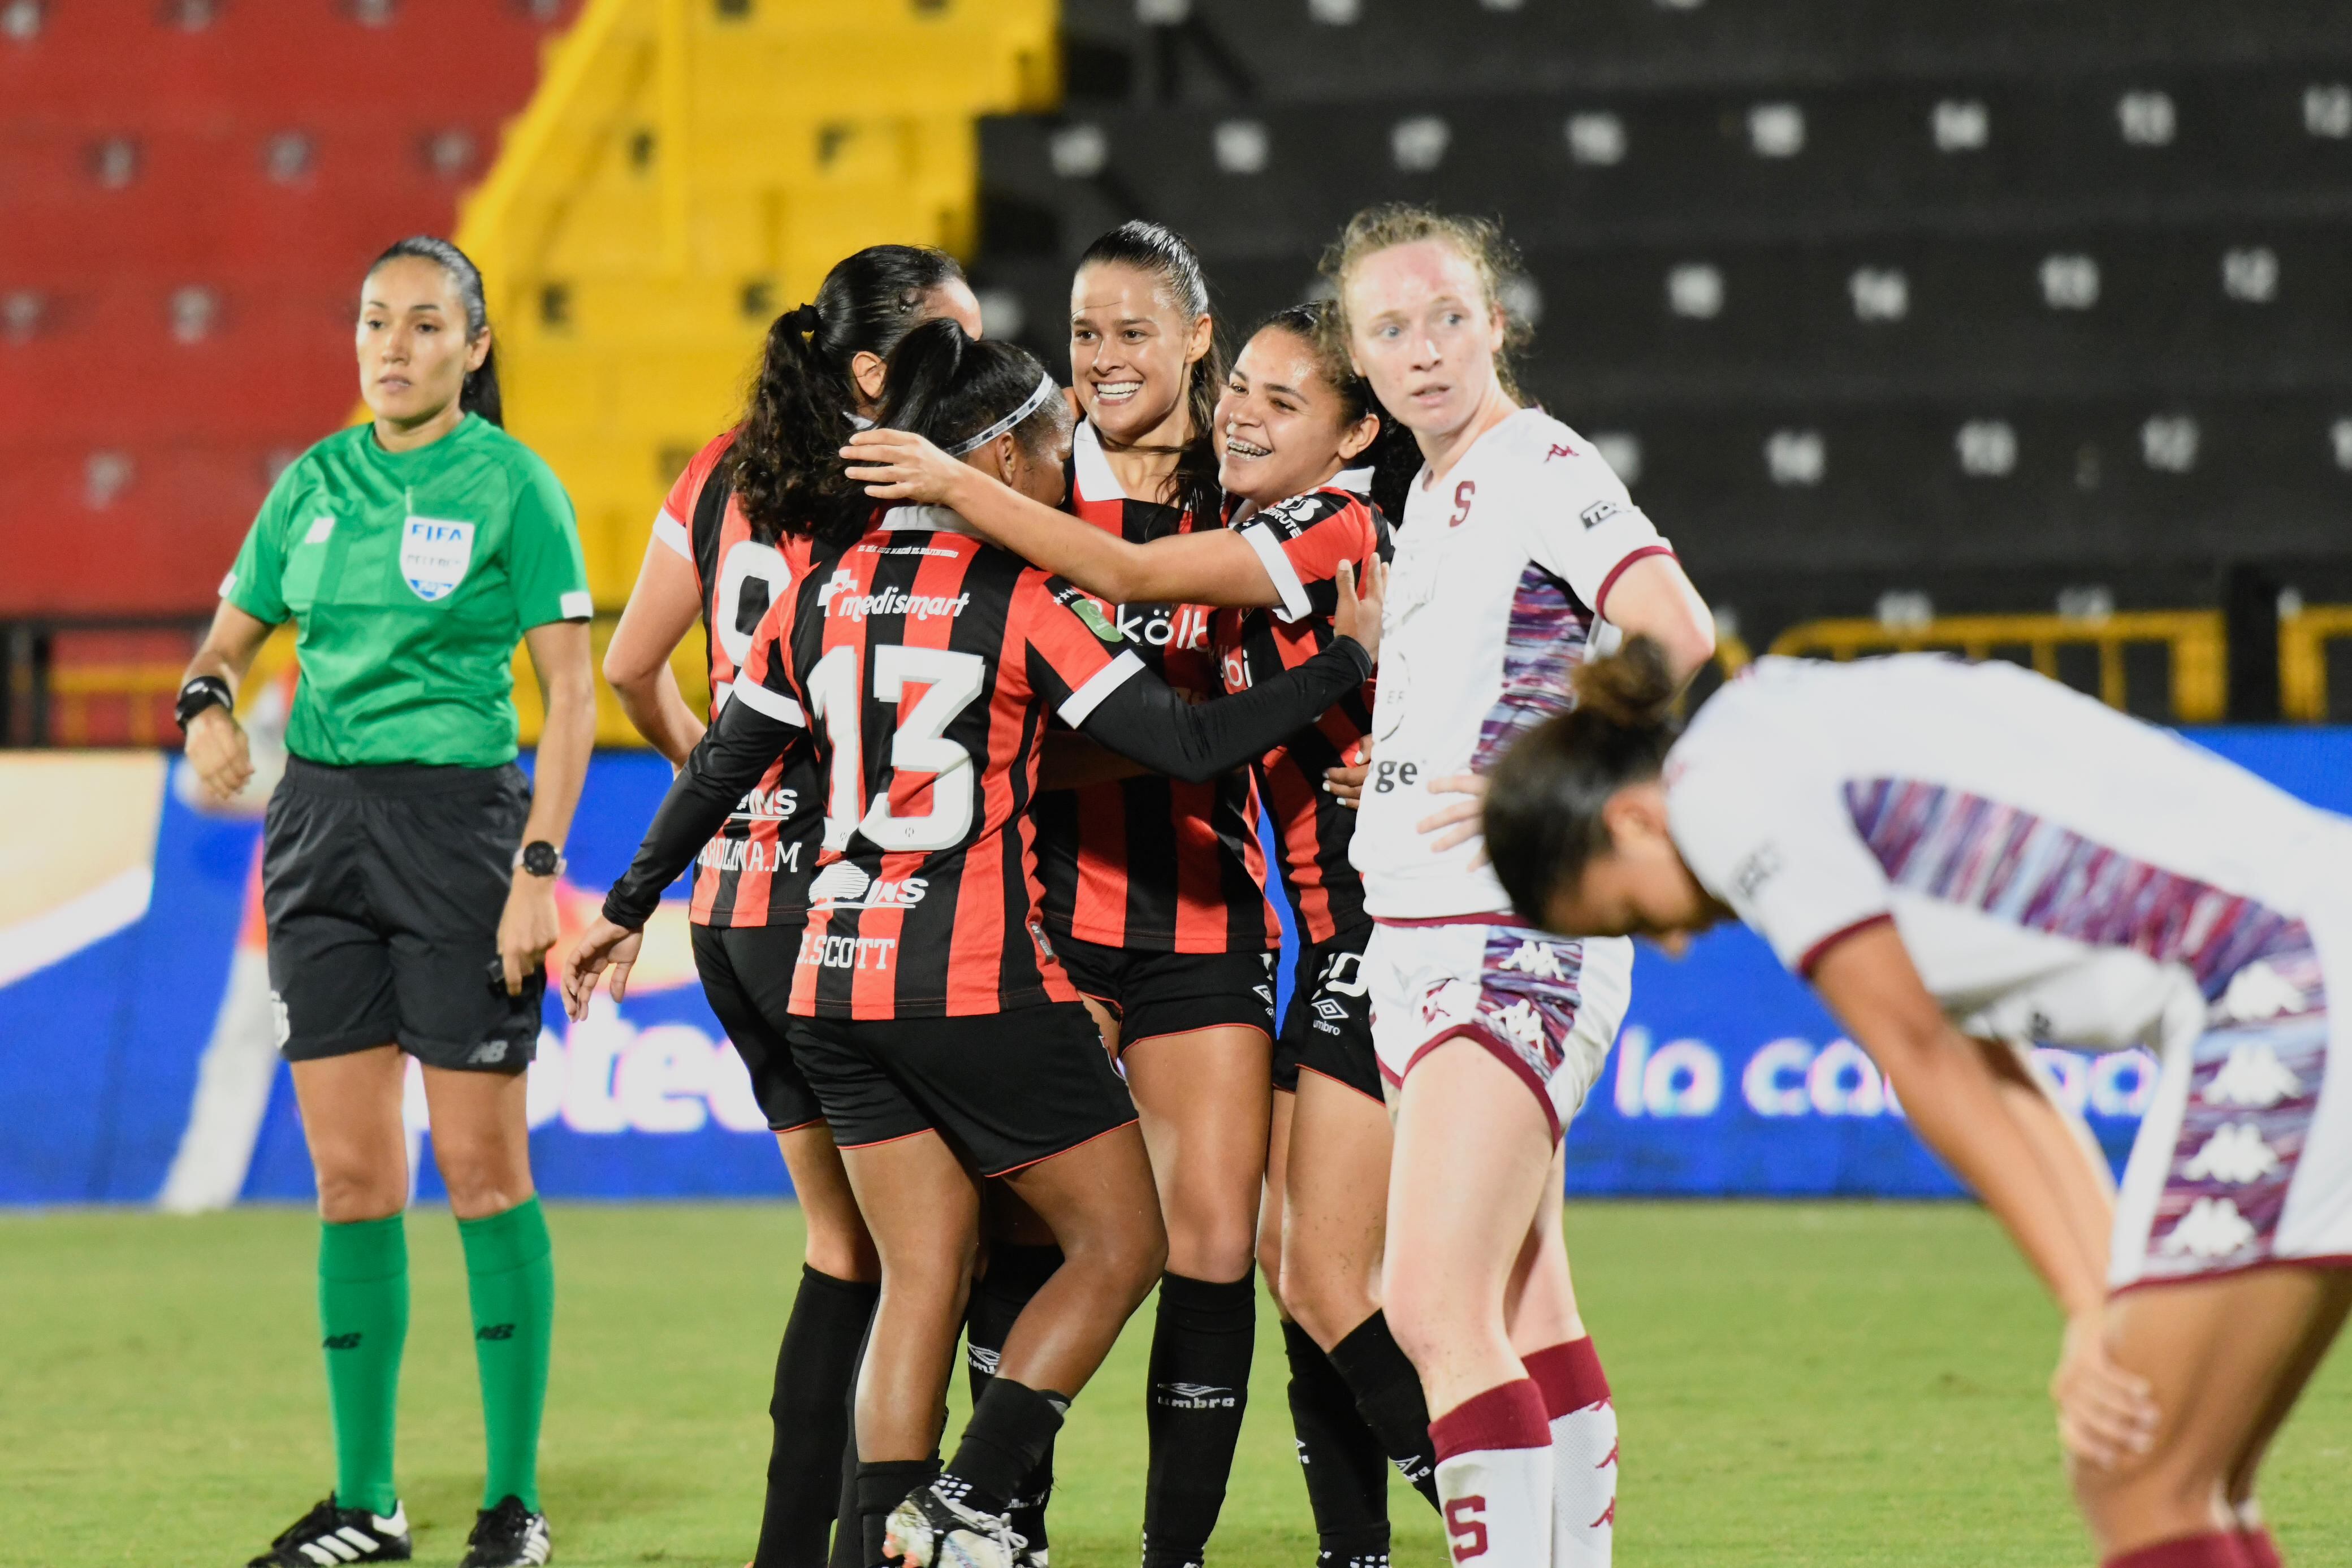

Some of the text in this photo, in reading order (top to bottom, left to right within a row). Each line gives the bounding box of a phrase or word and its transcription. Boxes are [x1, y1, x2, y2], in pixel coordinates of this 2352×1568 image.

[1450, 481, 1475, 527] S
[411, 523, 462, 542] FIFA
[1258, 507, 1303, 539] EIRUTE
[838, 586, 970, 622] medismart
[1117, 603, 1209, 652] kölb
[806, 644, 986, 852] 13
[1372, 759, 1418, 794] ge
[749, 789, 798, 815] INS
[1312, 1019, 1341, 1036] umbro
[1157, 1396, 1235, 1409] umbro
[1445, 1495, 1488, 1564] S
